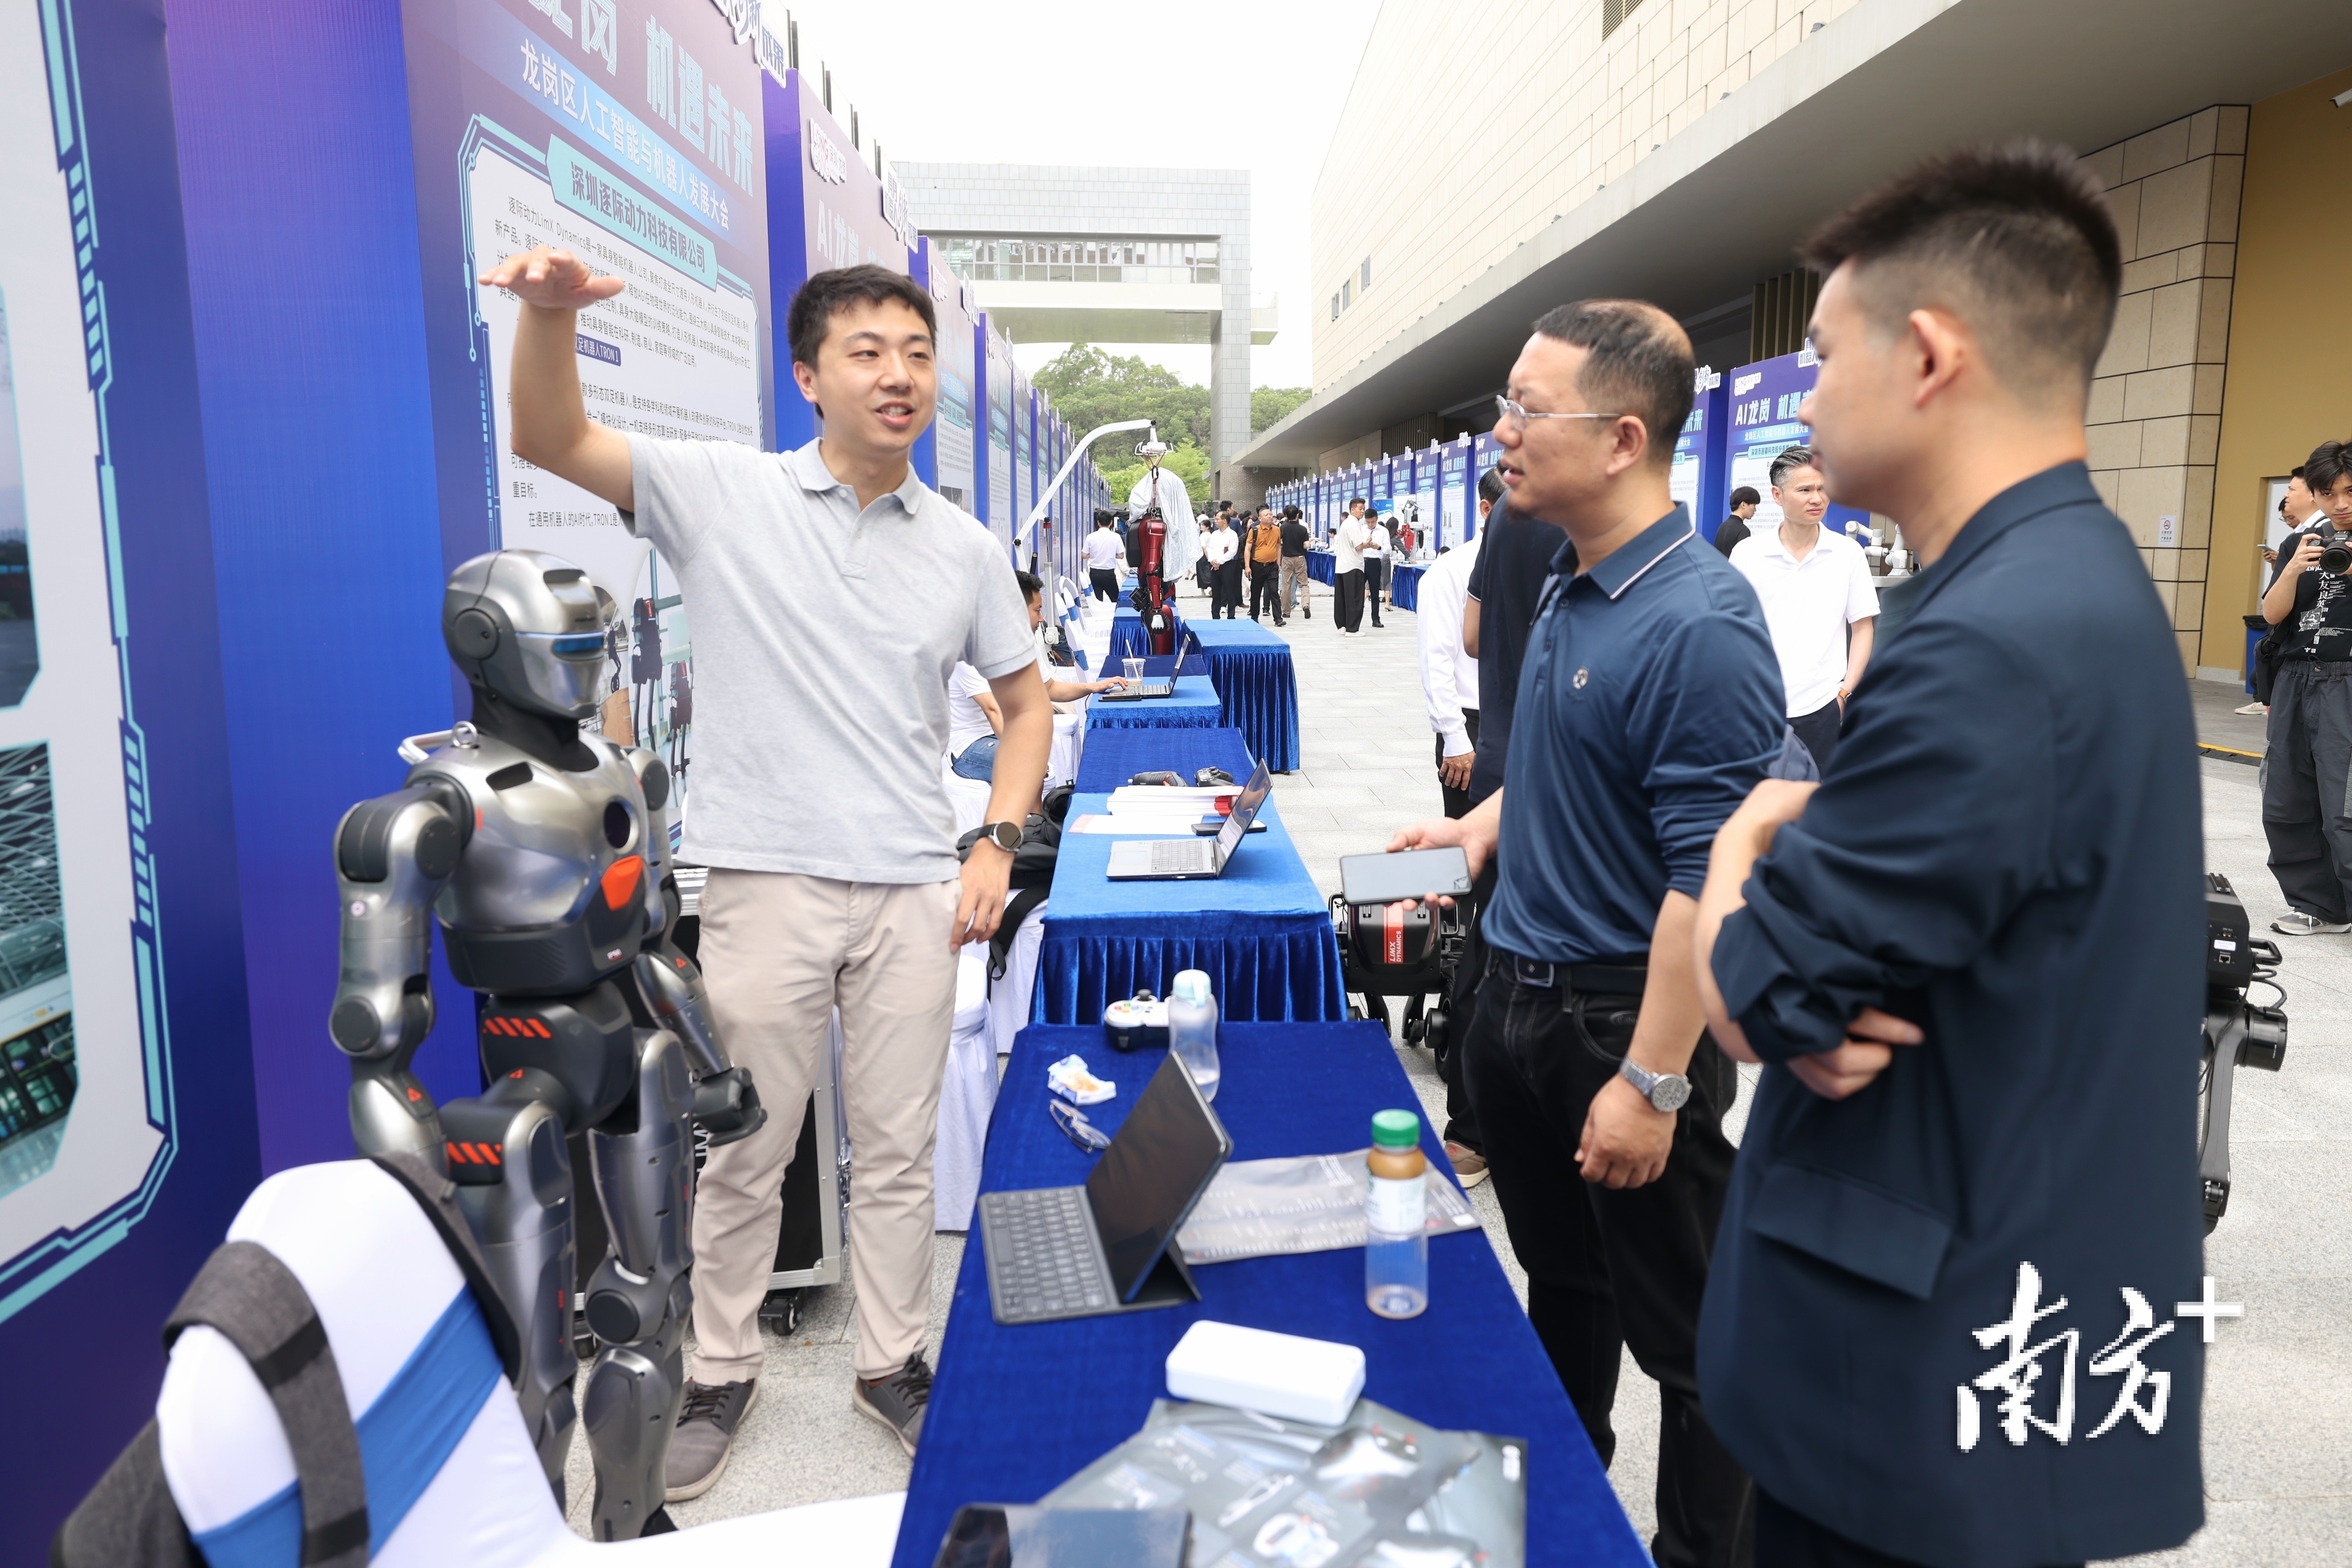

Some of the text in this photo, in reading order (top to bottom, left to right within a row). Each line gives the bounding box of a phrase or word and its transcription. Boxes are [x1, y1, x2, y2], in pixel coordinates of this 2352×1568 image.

[528, 0, 753, 197] 岗 机遇未来
[521, 38, 729, 231] 龙岗区人工智能与机器人发展大会
[508, 196, 554, 233] 逐际动力LimX
[571, 161, 706, 273] 深圳逐际动力科技有限公司
[1681, 409, 1703, 433] 未来
[1735, 398, 1771, 426] AI龙岗
[1744, 424, 1809, 441] 龙岗区人工智能与机器人发展大会
[2315, 571, 2330, 610] 大友良英
